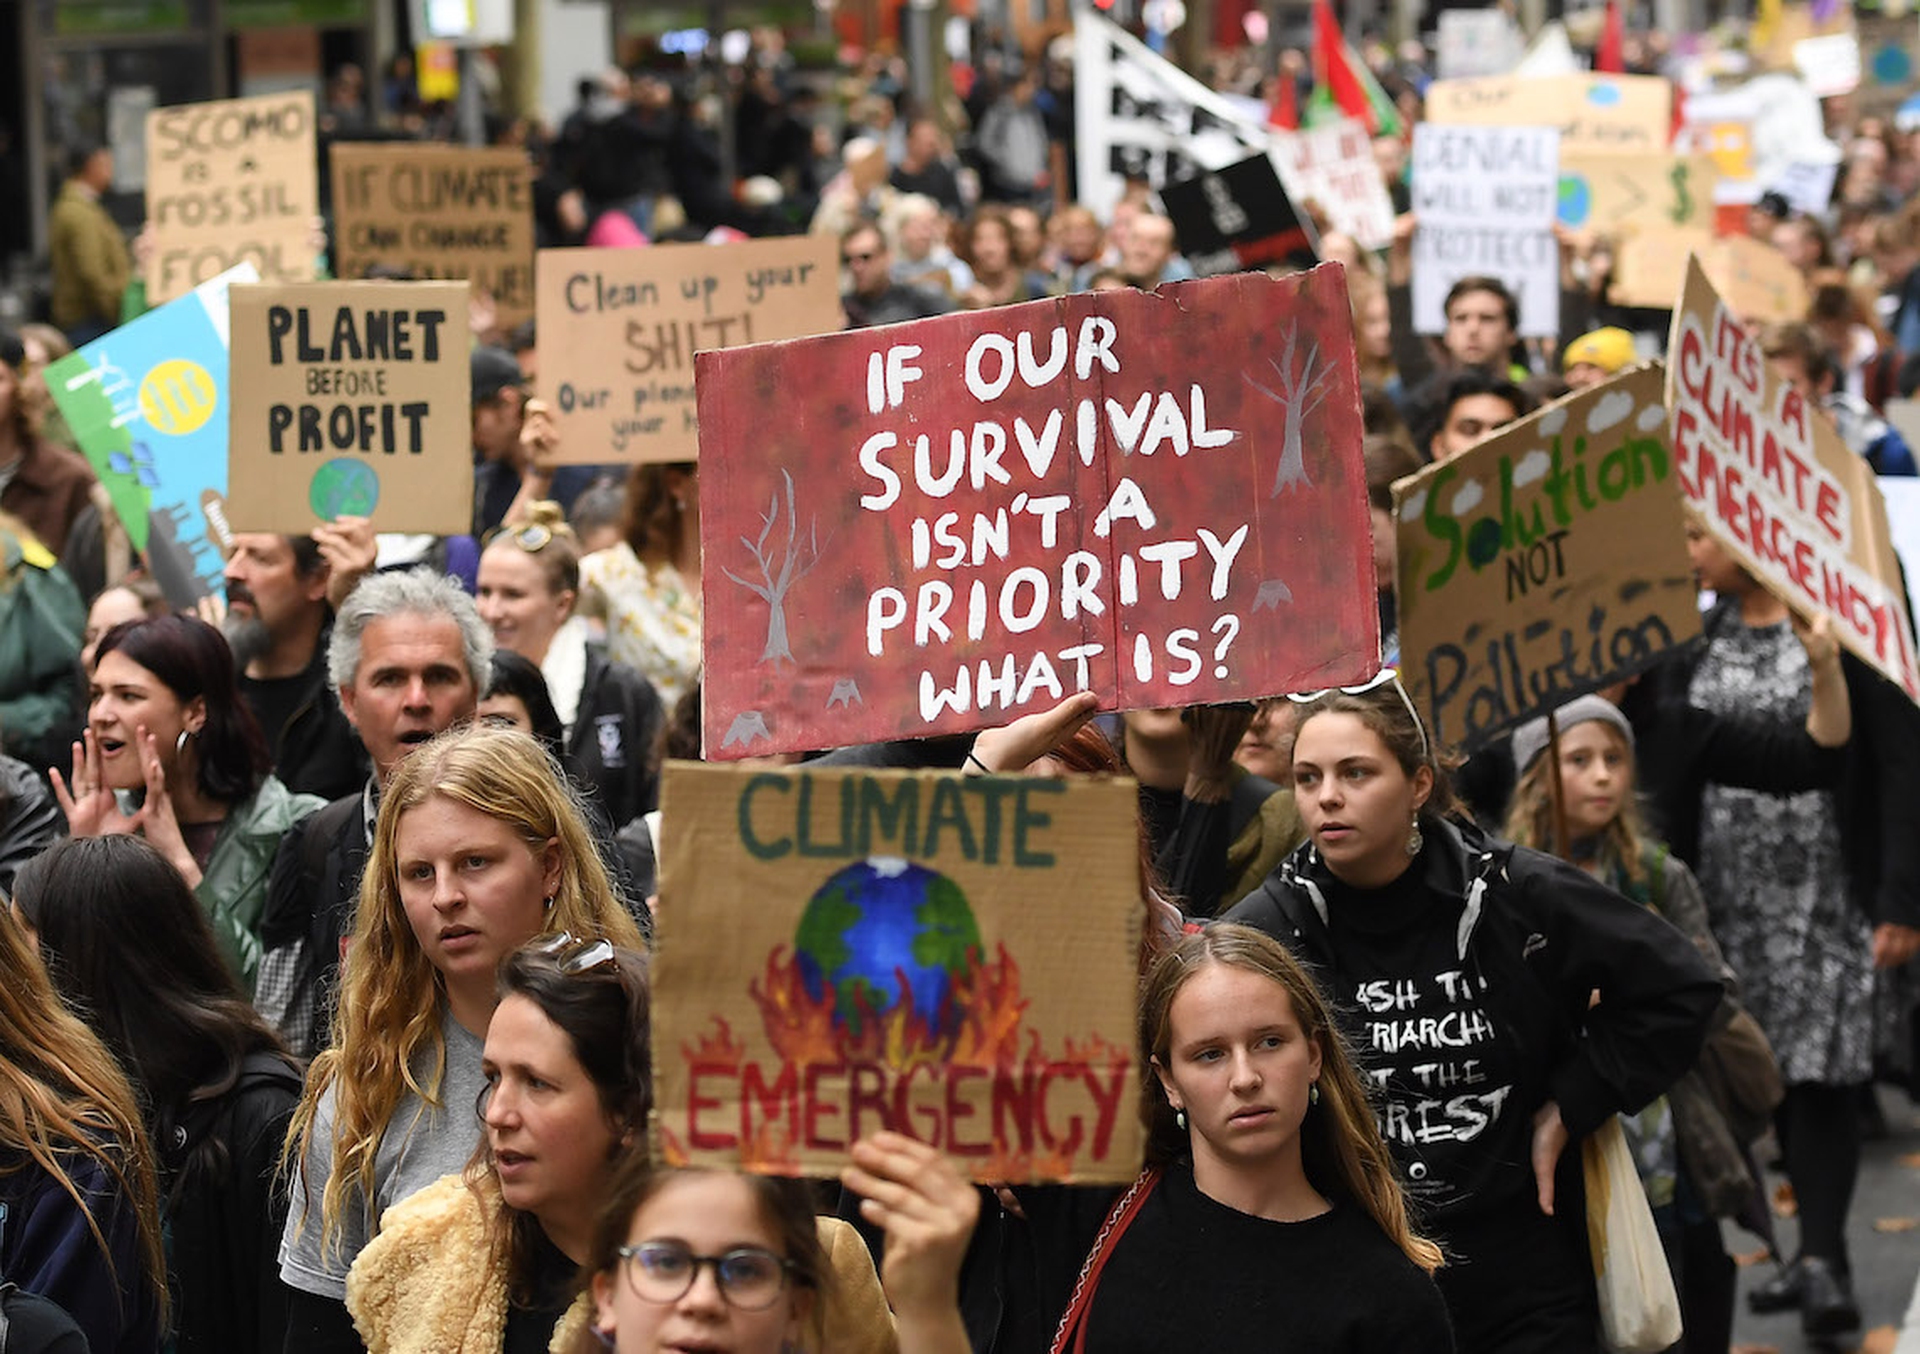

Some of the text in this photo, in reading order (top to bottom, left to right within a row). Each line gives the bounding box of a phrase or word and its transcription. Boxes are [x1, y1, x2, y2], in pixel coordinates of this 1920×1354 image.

[344, 164, 523, 213] IF CLIMATE
[565, 263, 815, 313] Clean up your
[268, 305, 445, 365] PLANET
[306, 367, 387, 396] BEFORE
[867, 316, 1121, 414] IF OUR
[269, 403, 429, 454] PROFIT
[559, 383, 610, 413] Our
[1681, 328, 1842, 542] CLIMATE
[859, 384, 1242, 511] SURVIVAL
[911, 477, 1157, 570] ISN'T A
[1424, 434, 1668, 593] Solution
[866, 524, 1249, 657] PRIORITY
[1505, 530, 1570, 602] NOT
[919, 614, 1240, 722] WHAT IS?
[1425, 605, 1675, 742] Pollution
[738, 772, 1066, 868] CLIMATE
[687, 1060, 1129, 1162] EMERGENCY
[1376, 1085, 1513, 1146] REST
[1411, 1060, 1487, 1088] THE
